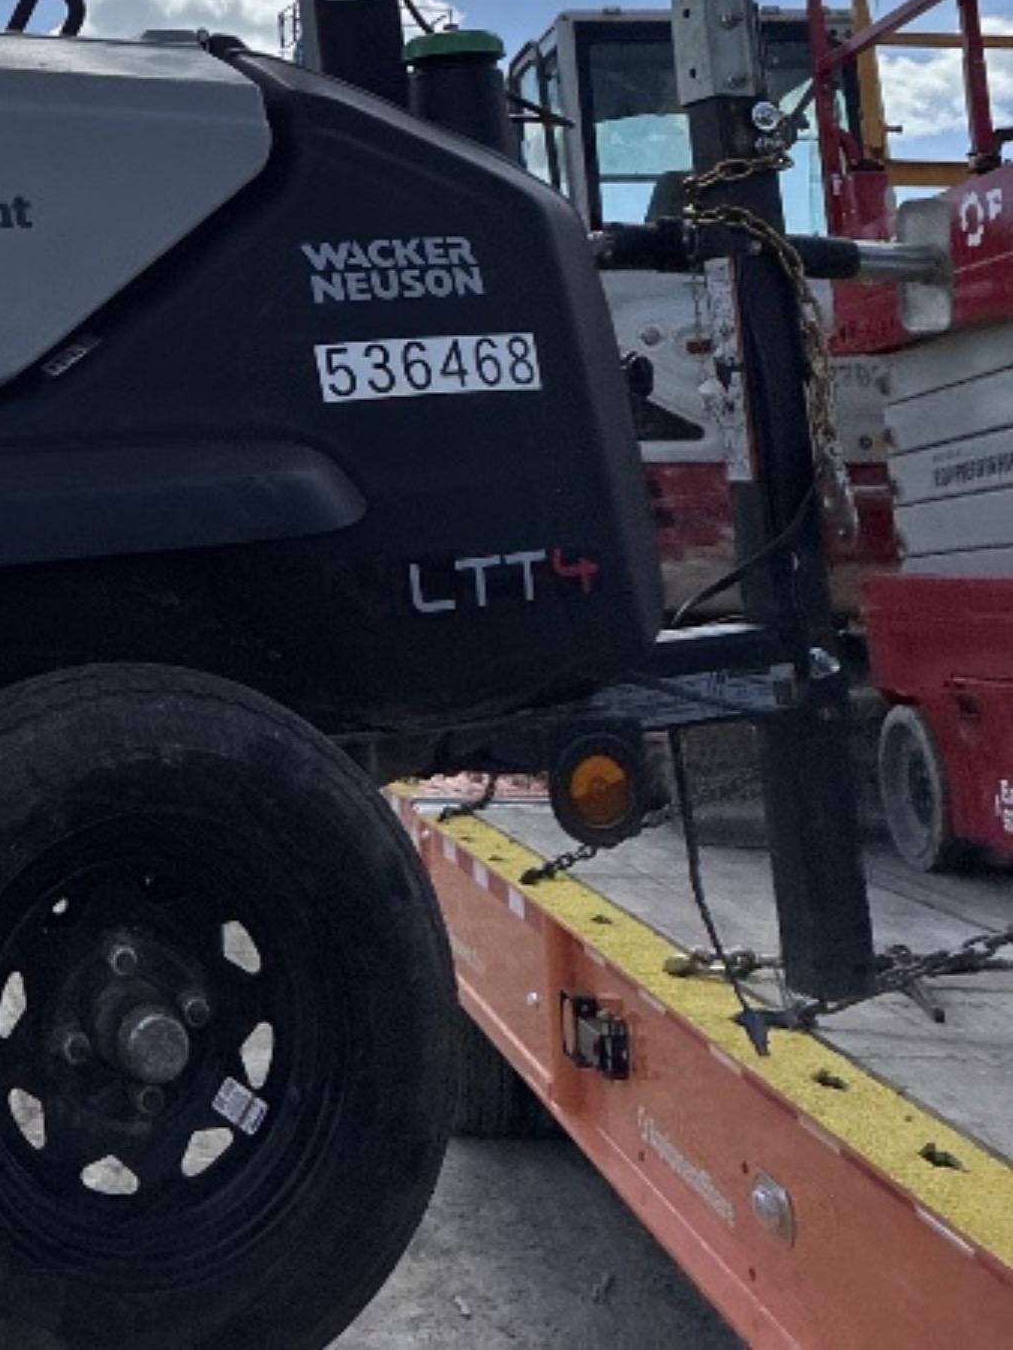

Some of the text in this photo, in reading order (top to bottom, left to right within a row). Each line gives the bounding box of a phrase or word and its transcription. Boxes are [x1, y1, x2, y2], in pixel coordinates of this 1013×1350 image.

[301, 236, 478, 271] WACKER
[310, 266, 486, 303] NEUSON
[326, 335, 535, 397] 536468
[409, 548, 599, 613] LTT4
